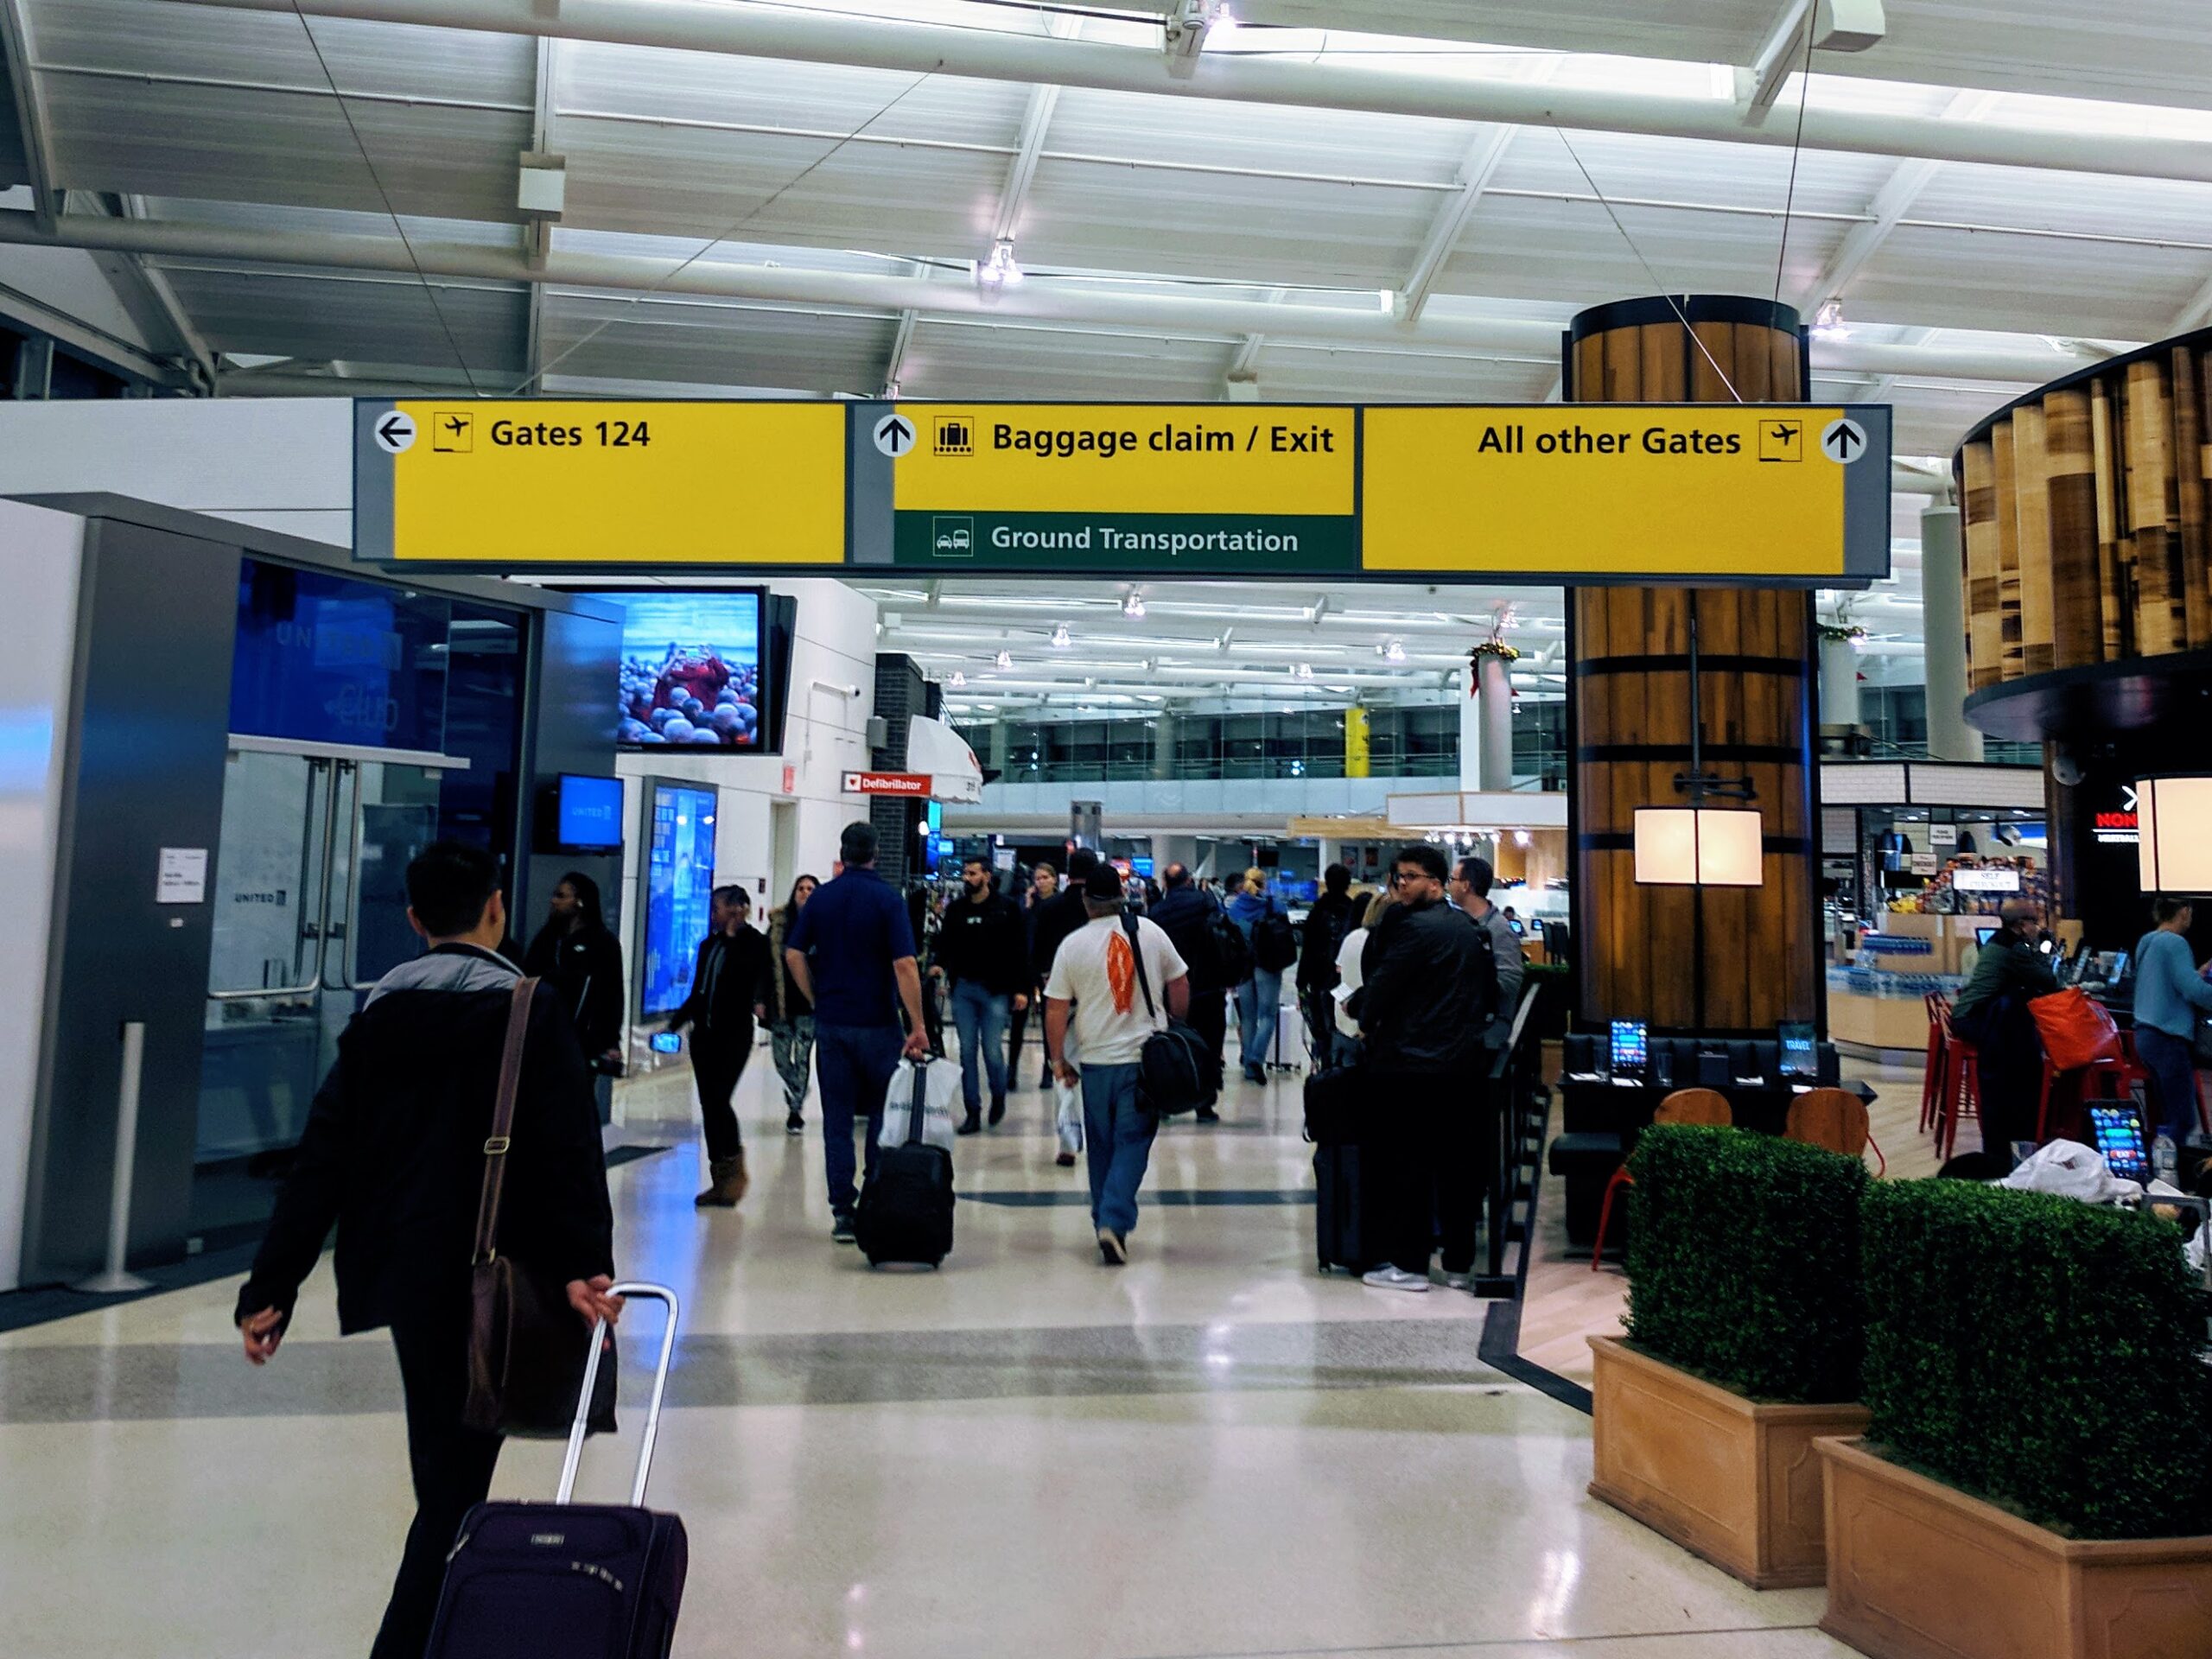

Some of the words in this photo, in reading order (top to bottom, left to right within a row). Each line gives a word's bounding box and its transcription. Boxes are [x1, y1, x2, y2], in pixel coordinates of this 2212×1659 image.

[491, 420, 582, 447] Gates
[595, 420, 651, 447] 124
[994, 423, 1138, 458] Baggage
[1148, 423, 1234, 452] claim
[1246, 425, 1259, 452] /
[1271, 426, 1334, 453] Exit
[1478, 425, 1523, 454] All
[1535, 425, 1631, 454] other
[1642, 427, 1741, 454] Gates
[992, 526, 1090, 549] Ground
[1099, 528, 1298, 556] Transportation
[276, 620, 375, 658] UNTED
[862, 778, 923, 791] Defibrillator
[572, 806, 603, 818] UNITED
[234, 893, 275, 904] UNITED
